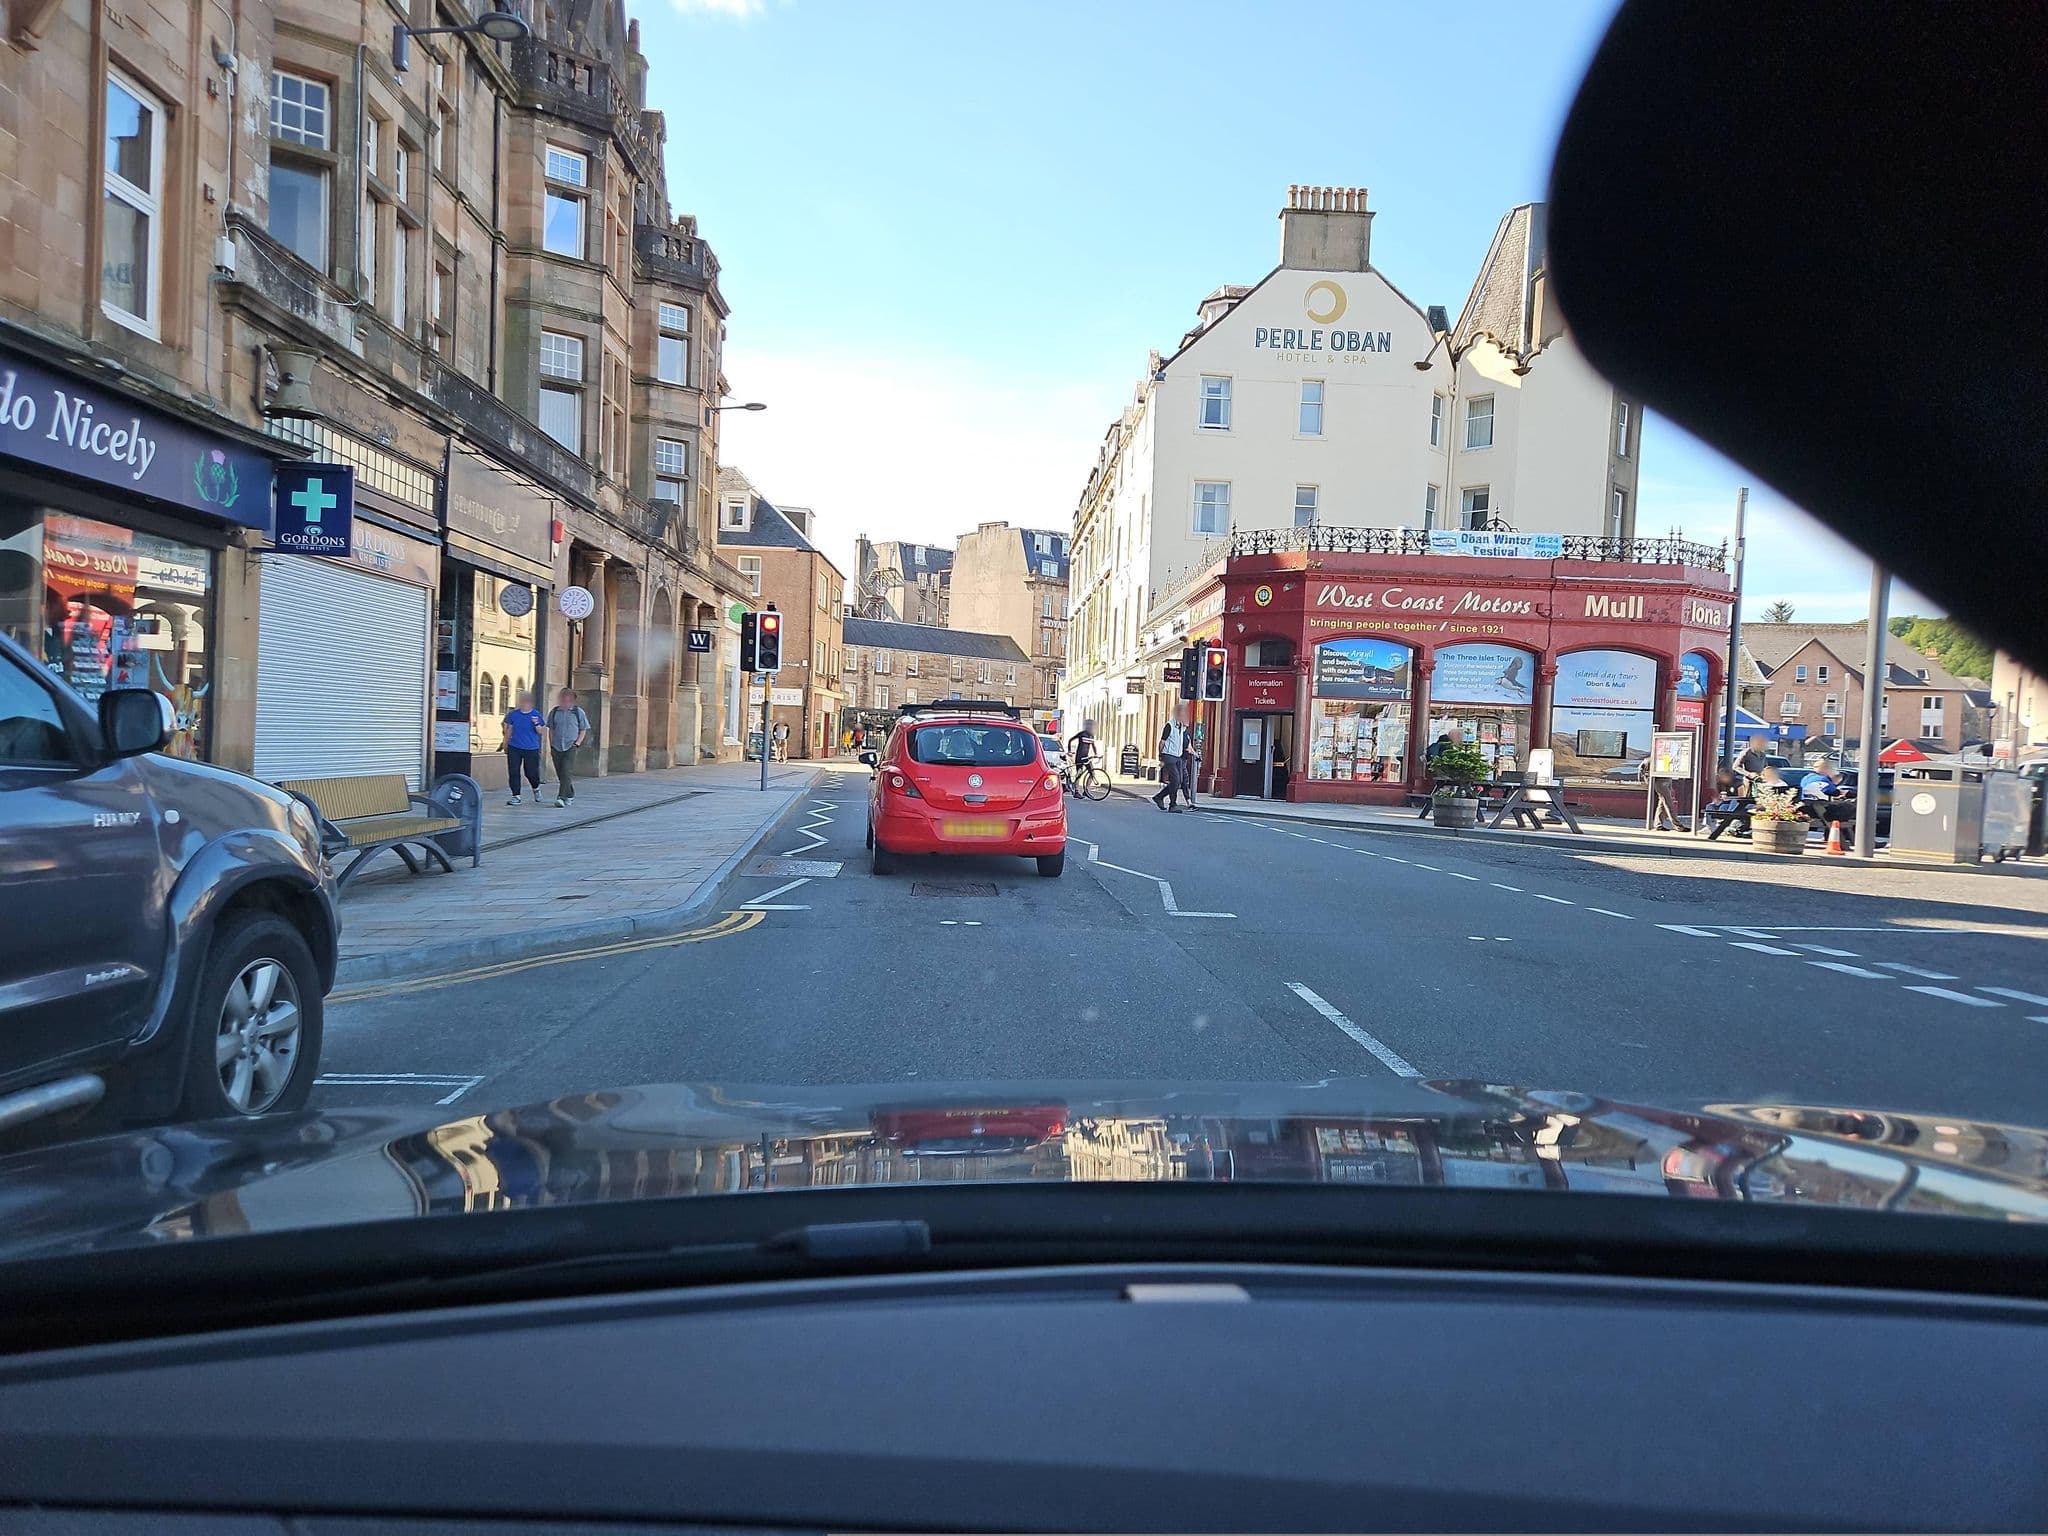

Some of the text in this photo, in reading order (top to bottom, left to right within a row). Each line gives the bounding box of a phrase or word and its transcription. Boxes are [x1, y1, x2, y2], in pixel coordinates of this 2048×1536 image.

[1255, 327, 1392, 353] PERLE OBAN
[1276, 353, 1368, 365] HOTEL & SPA
[46, 390, 156, 480] Nicely
[281, 532, 346, 546] GORDONS
[352, 528, 406, 561] ORDONS
[1461, 533, 1490, 544] Oban
[1536, 536, 1559, 544] 15-24
[1473, 546, 1518, 557] Festival
[1534, 550, 1559, 558] 2024
[1317, 584, 1531, 614] West Coast Motors
[1585, 595, 1644, 618] Mull
[1692, 601, 1721, 626] Iona
[1310, 618, 1353, 630] bringing
[1356, 620, 1390, 631] people
[1393, 622, 1437, 633] together
[1450, 624, 1478, 633] since
[1482, 625, 1504, 634] 1921
[691, 633, 707, 645] W
[1479, 654, 1494, 662] Isles
[1497, 655, 1512, 663] Tour
